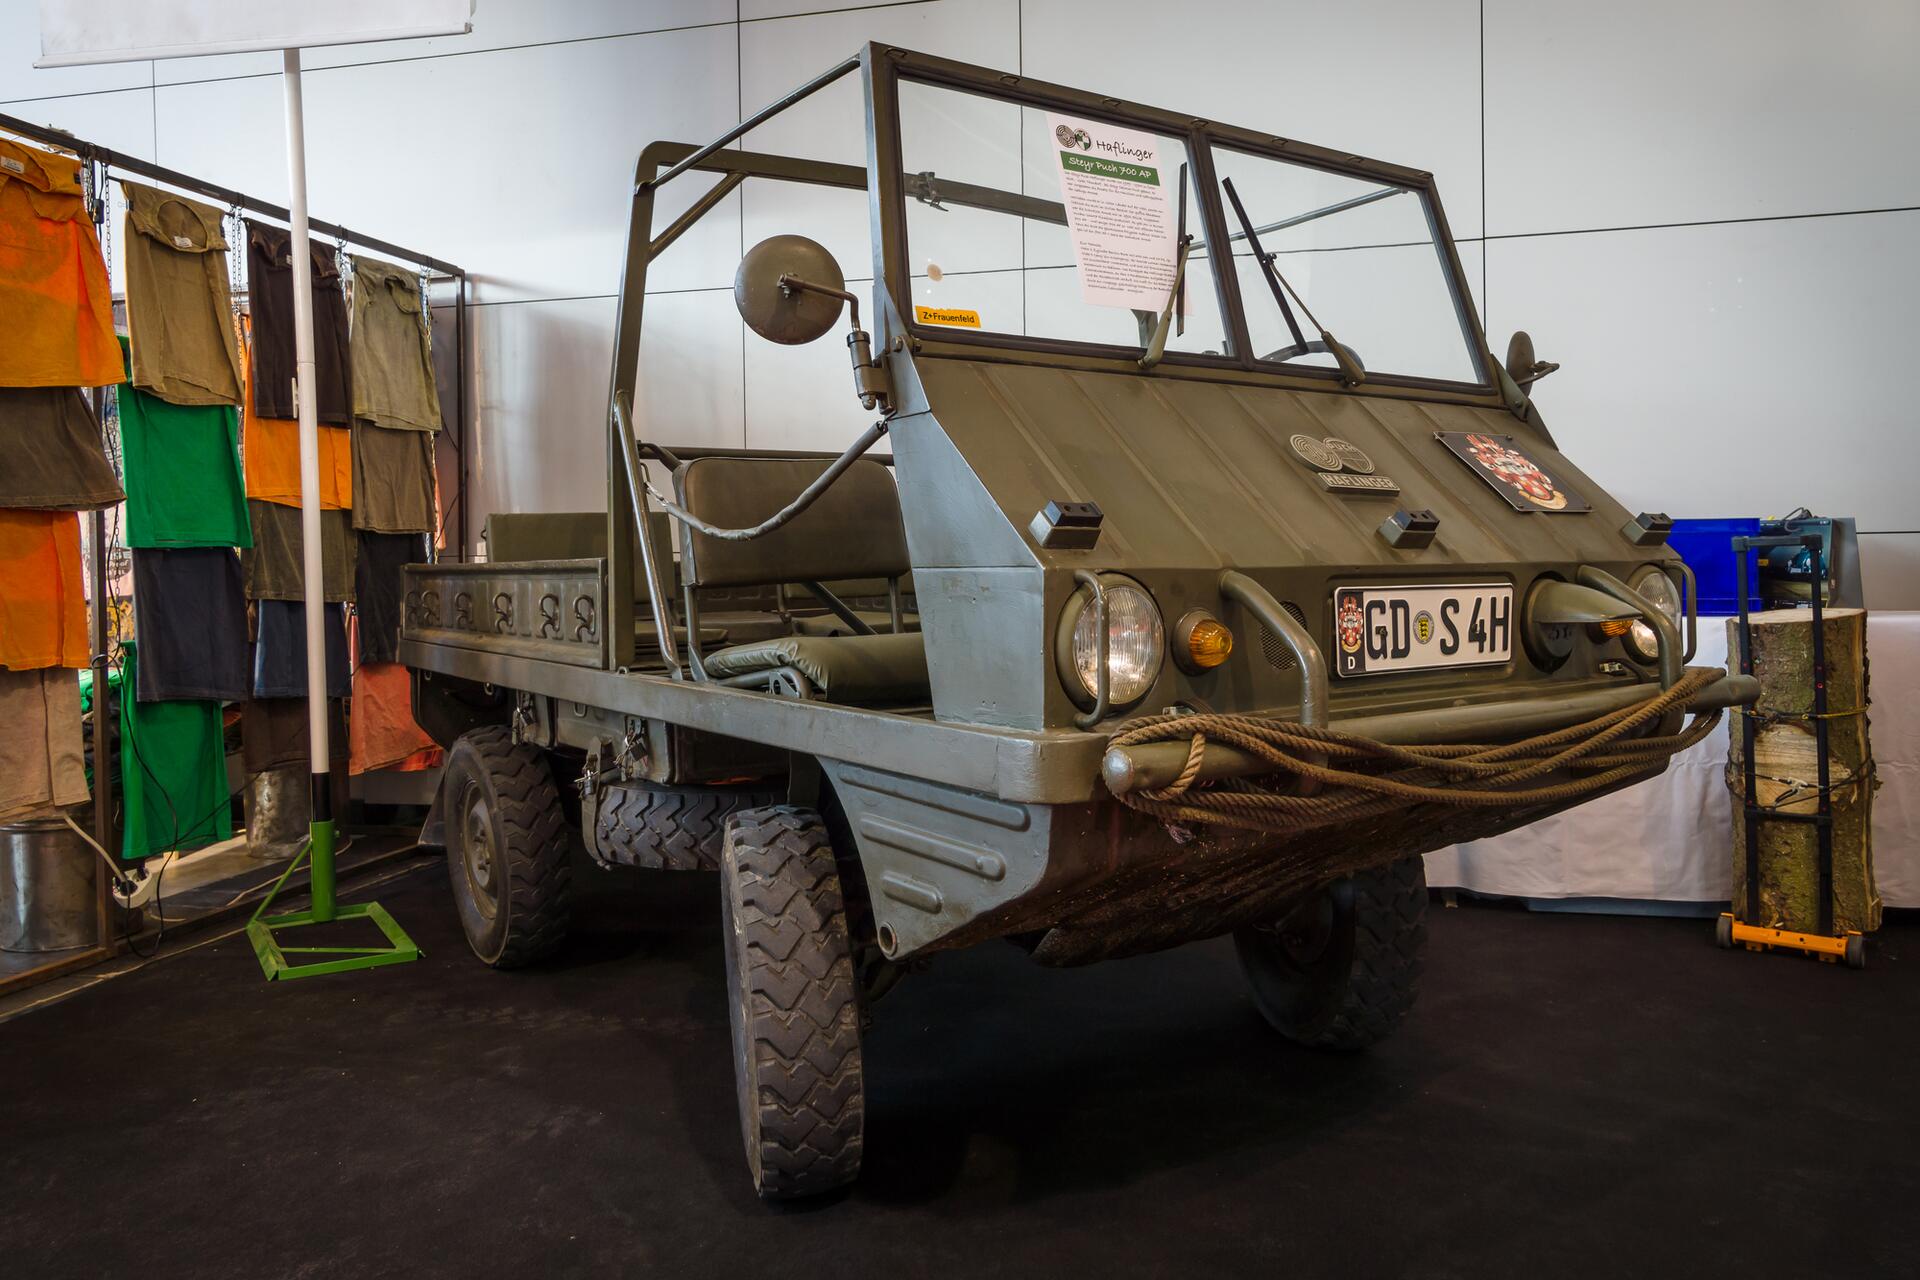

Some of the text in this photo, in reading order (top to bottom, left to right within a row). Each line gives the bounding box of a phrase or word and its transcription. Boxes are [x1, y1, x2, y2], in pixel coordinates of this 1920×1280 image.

[1096, 140, 1153, 161] Haflinger
[1069, 157, 1152, 178] Steyr Puch 700 AP
[923, 311, 975, 323] Z+Frauenfeld
[1323, 475, 1396, 489] HAFLINGER
[1364, 596, 1510, 660] GD S 4H
[1347, 656, 1357, 670] D
